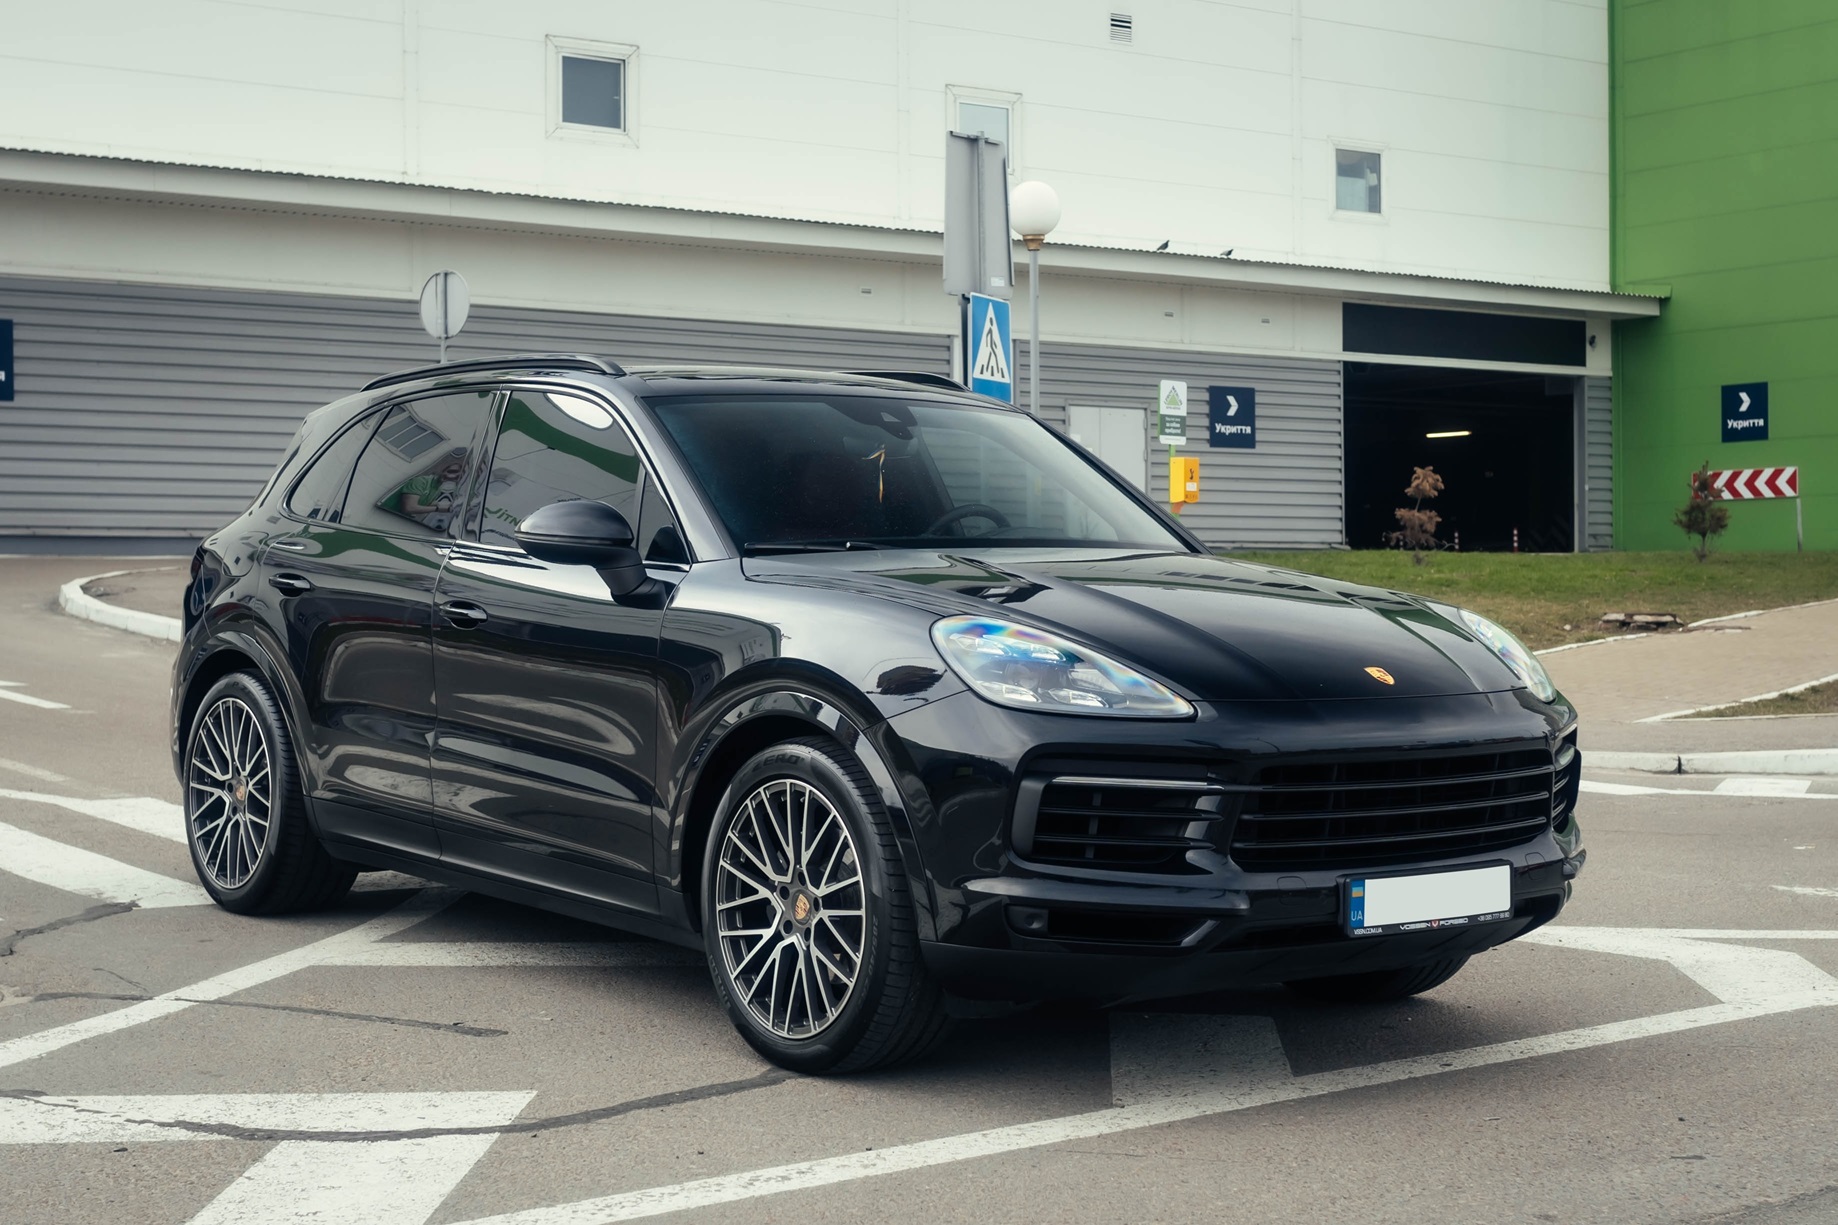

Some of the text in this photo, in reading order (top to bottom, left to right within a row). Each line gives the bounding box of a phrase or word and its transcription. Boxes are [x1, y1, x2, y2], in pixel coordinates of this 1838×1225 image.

[1215, 423, 1251, 435] Укриття
[1727, 418, 1764, 430] Укриття
[1351, 910, 1363, 921] UA
[1399, 921, 1431, 931] VOSSEN
